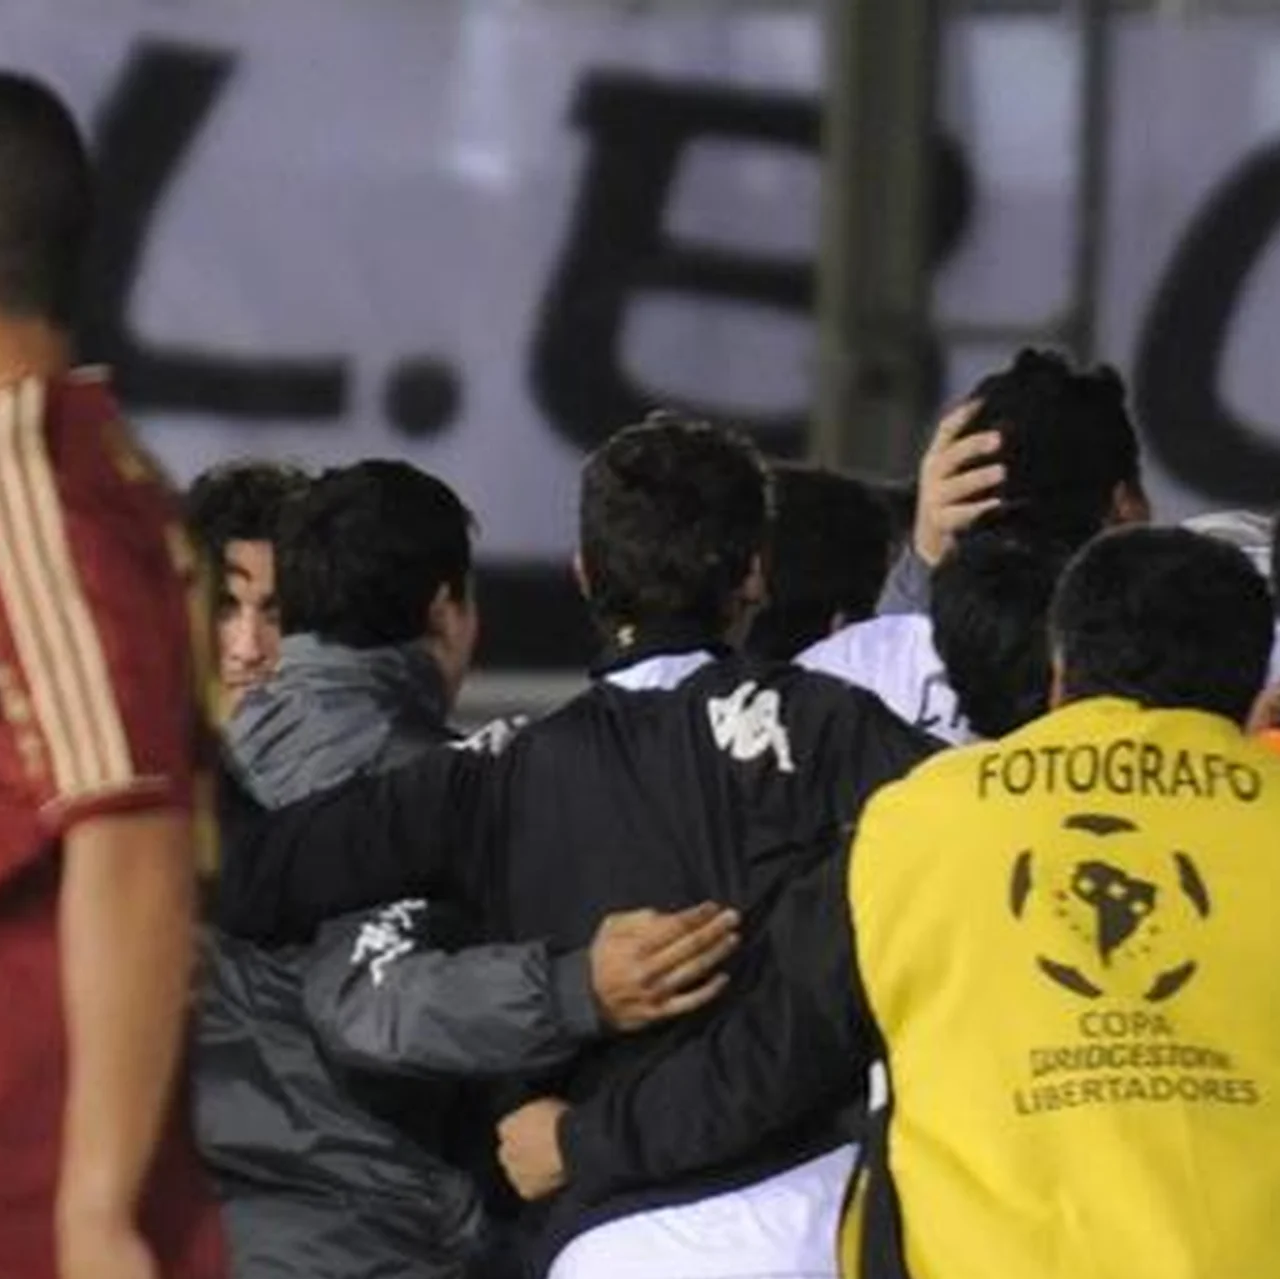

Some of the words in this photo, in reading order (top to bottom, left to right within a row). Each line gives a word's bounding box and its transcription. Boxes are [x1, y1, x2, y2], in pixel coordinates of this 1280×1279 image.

[976, 738, 1264, 803] FOTOGRAFO
[1078, 1010, 1173, 1039] COPA
[1013, 1074, 1262, 1116] LIBERTADORES
